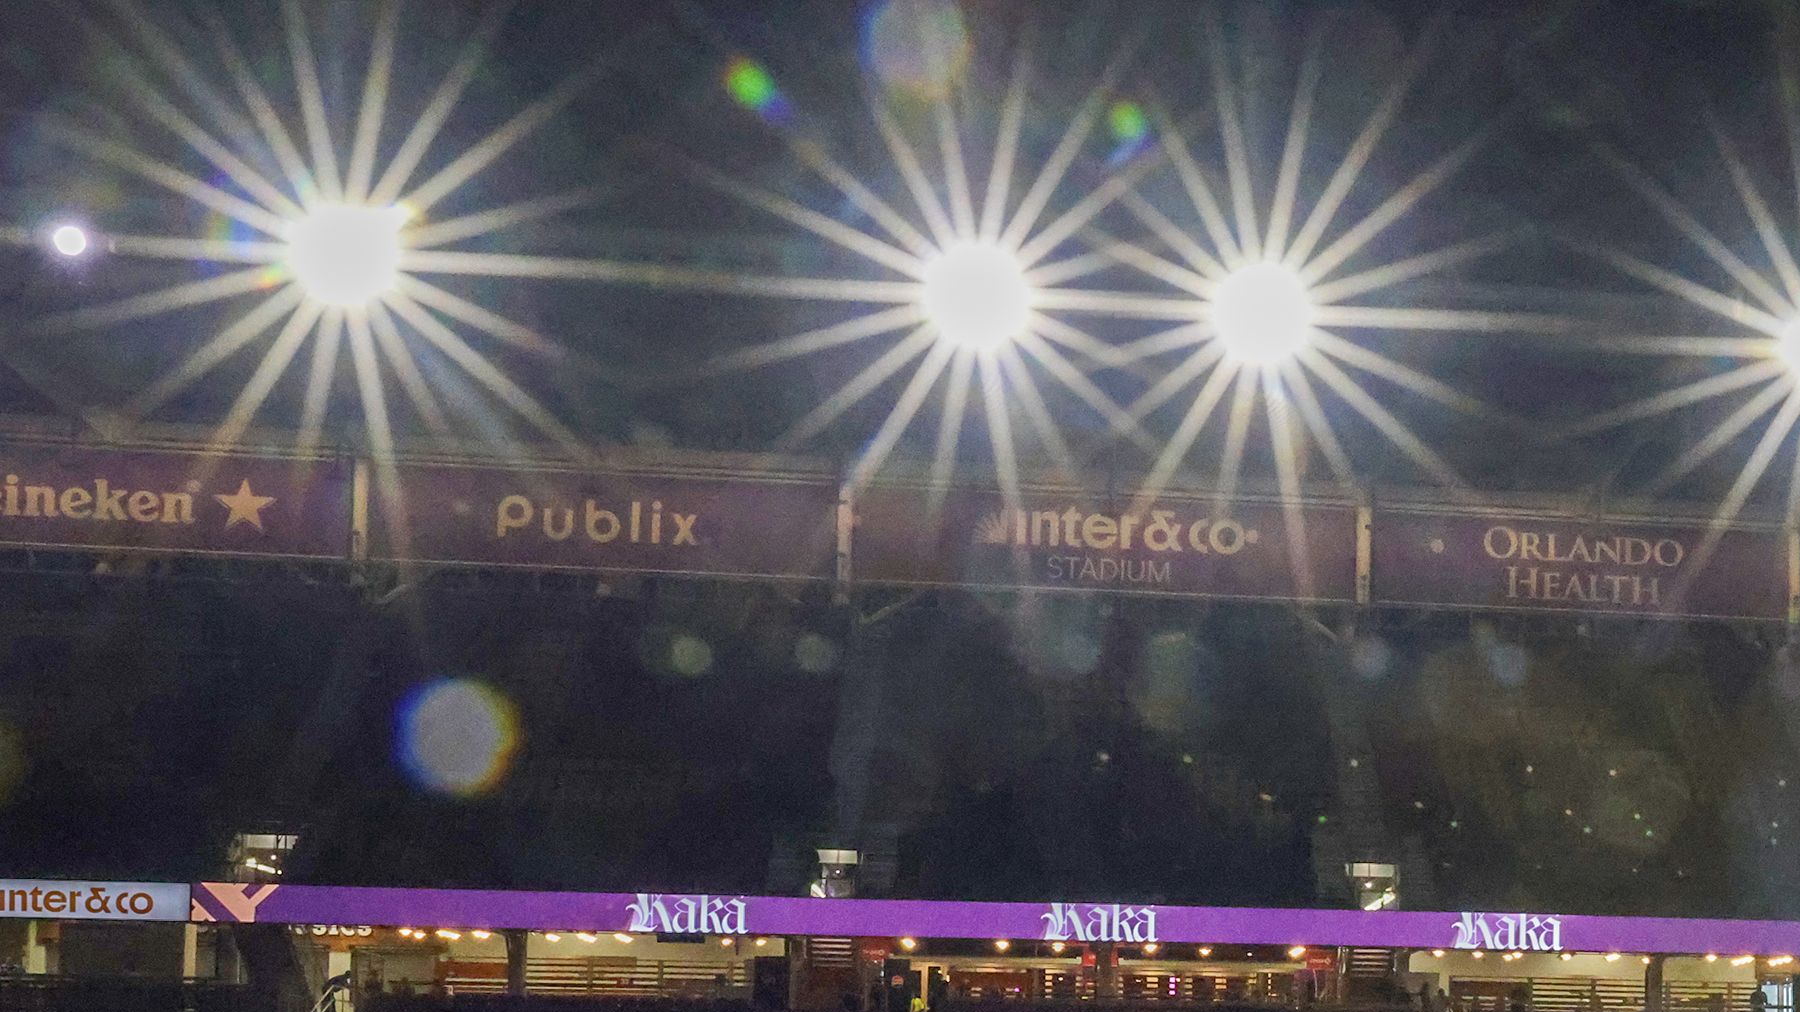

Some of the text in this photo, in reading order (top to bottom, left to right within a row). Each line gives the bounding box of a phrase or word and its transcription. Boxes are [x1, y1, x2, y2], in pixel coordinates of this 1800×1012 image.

[0, 474, 195, 524] ineken
[497, 495, 698, 545] Publix
[1483, 526, 1684, 567] ORLANDO
[1049, 556, 1171, 583] STADIUM
[1505, 566, 1661, 604] HEALTH
